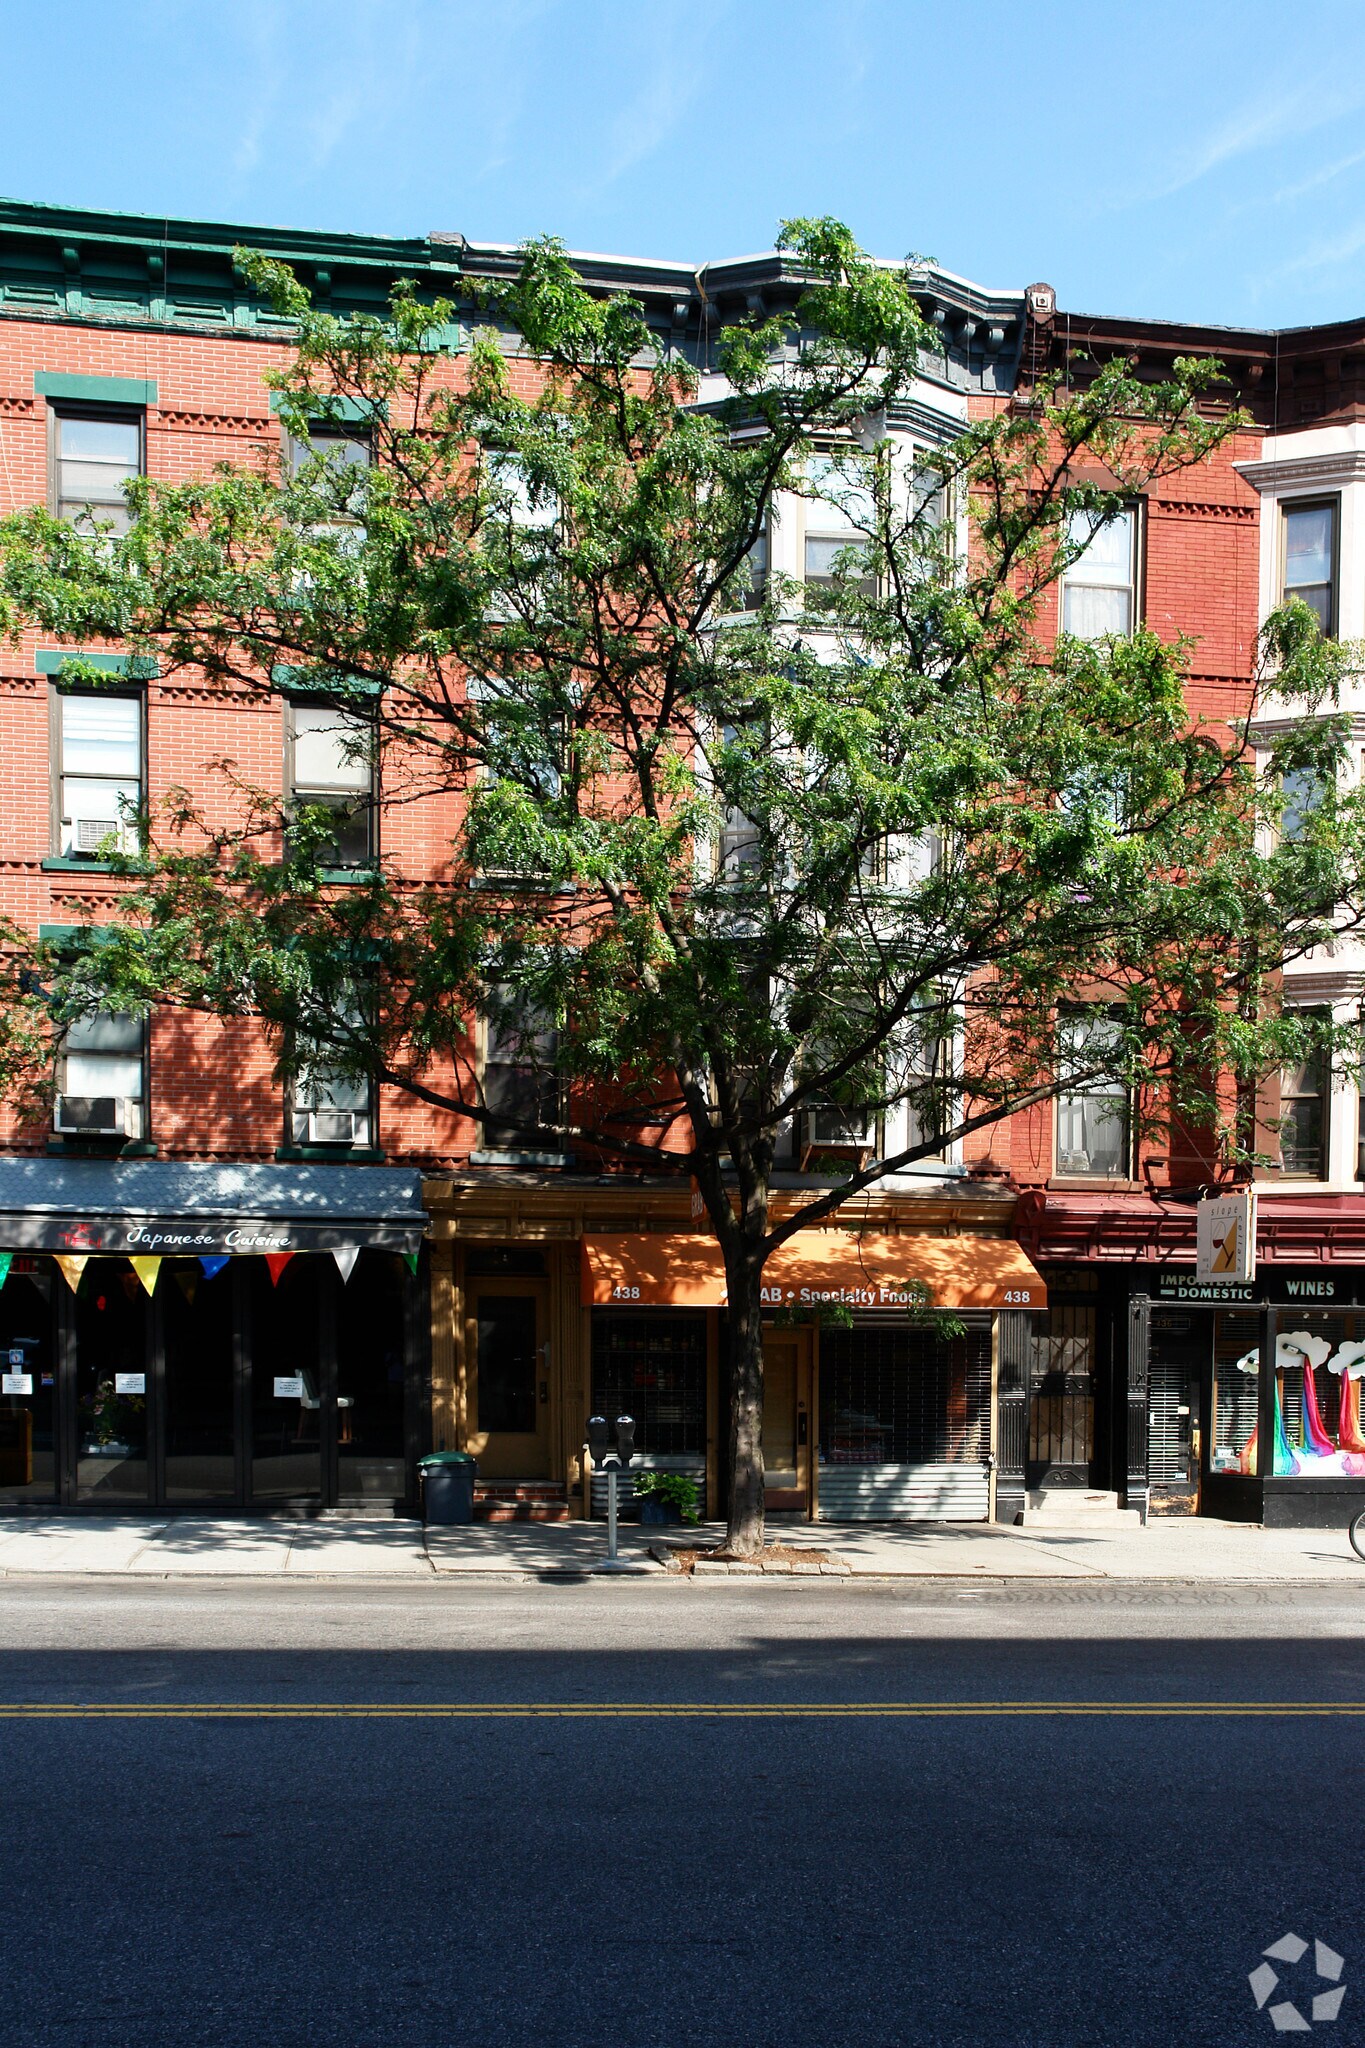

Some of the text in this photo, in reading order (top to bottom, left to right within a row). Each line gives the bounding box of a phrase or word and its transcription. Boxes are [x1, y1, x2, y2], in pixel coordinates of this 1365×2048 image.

[1210, 1206, 1238, 1216] slope
[57, 1233, 102, 1249] TEN
[126, 1226, 292, 1250] Japanese Cuisine
[612, 1286, 640, 1299] 438
[1178, 1287, 1253, 1299] DOMESTIC
[1285, 1280, 1335, 1296] WINES
[800, 1287, 876, 1305] Specialty
[1004, 1290, 1030, 1303] 438
